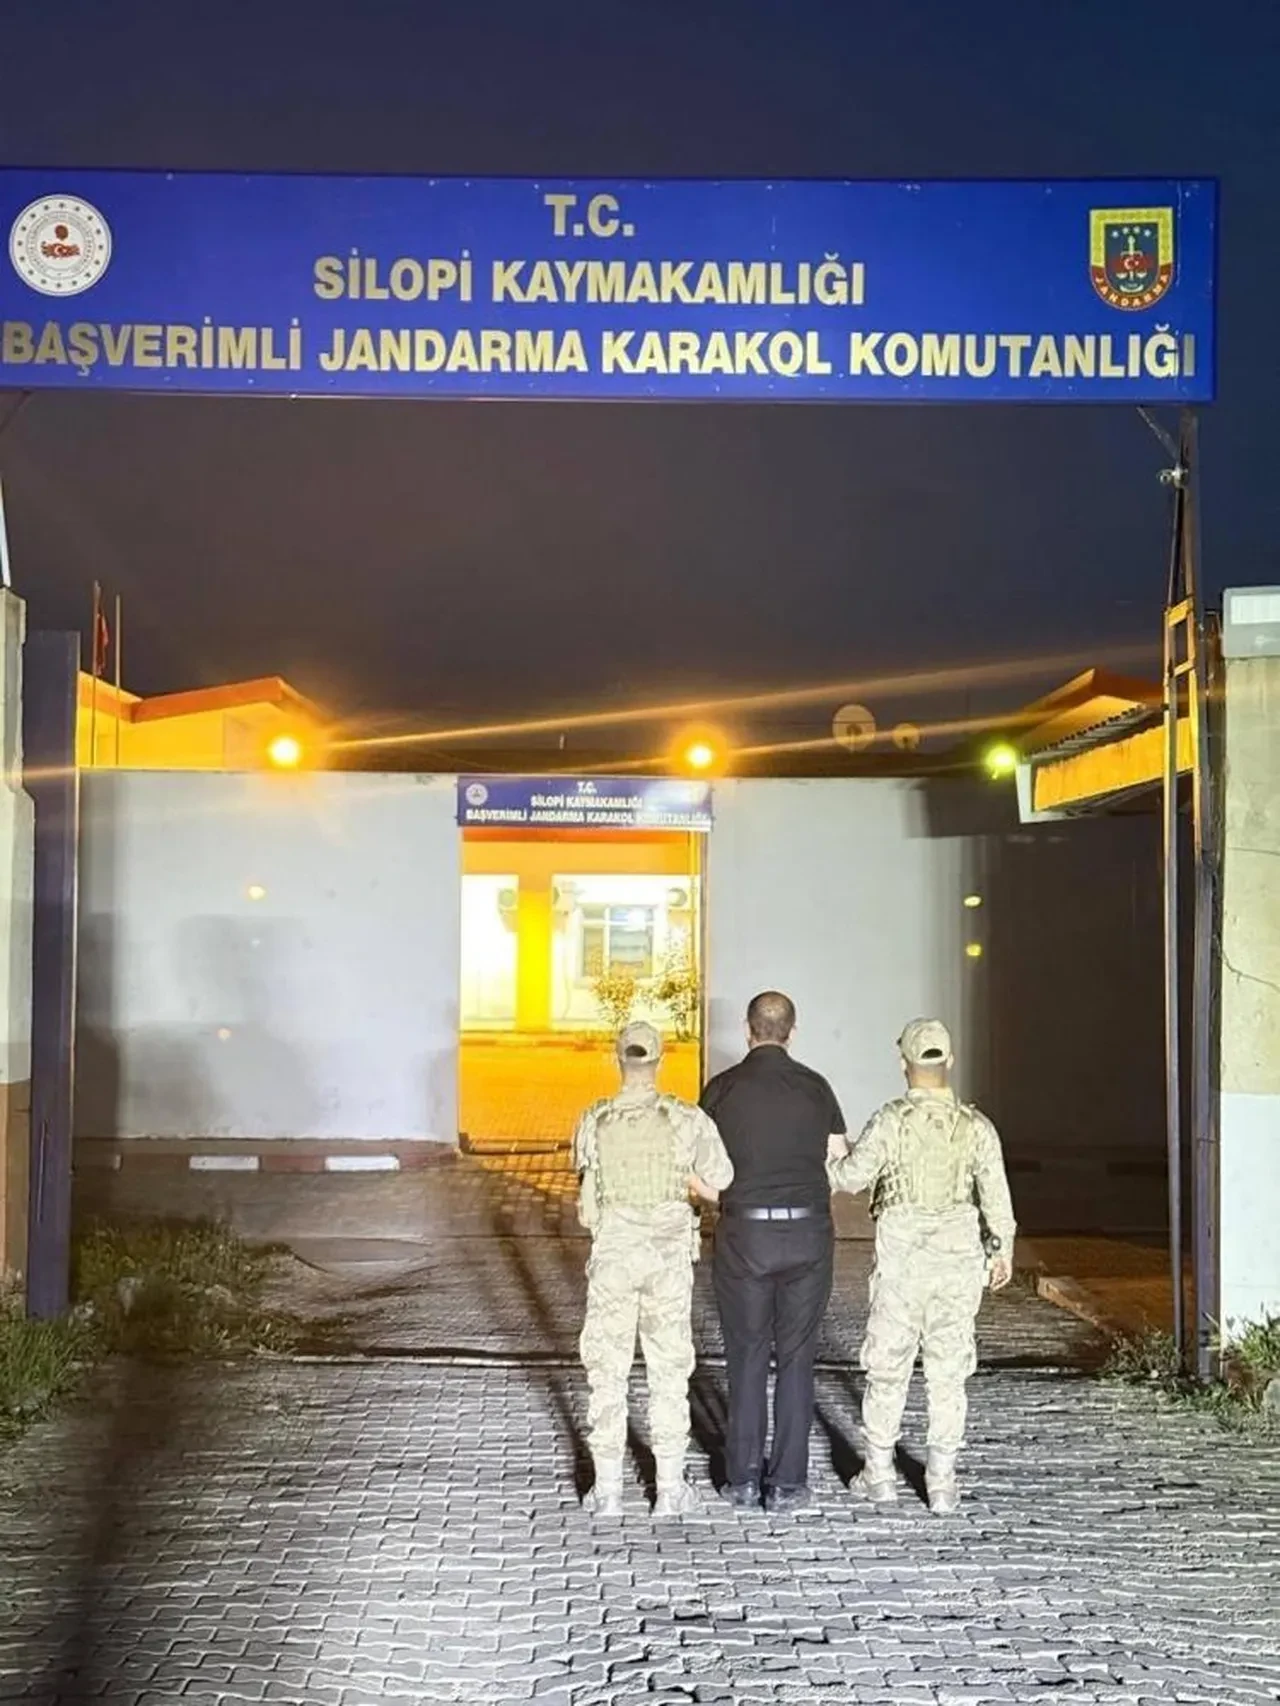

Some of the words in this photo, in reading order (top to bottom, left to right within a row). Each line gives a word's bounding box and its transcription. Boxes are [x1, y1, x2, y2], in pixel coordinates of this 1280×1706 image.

[544, 194, 635, 236] T.C.
[313, 247, 473, 301] SİLOPİ
[491, 252, 865, 305] KAYMAKAMLIĞI
[2, 316, 301, 376] BAŞVERİMLİ
[318, 329, 589, 372] JANDARMA
[601, 330, 832, 376] KARAKOL
[848, 323, 1195, 378] KOMUTANLIĞI
[577, 781, 597, 794] T.C.
[529, 811, 585, 822] JANDARMA
